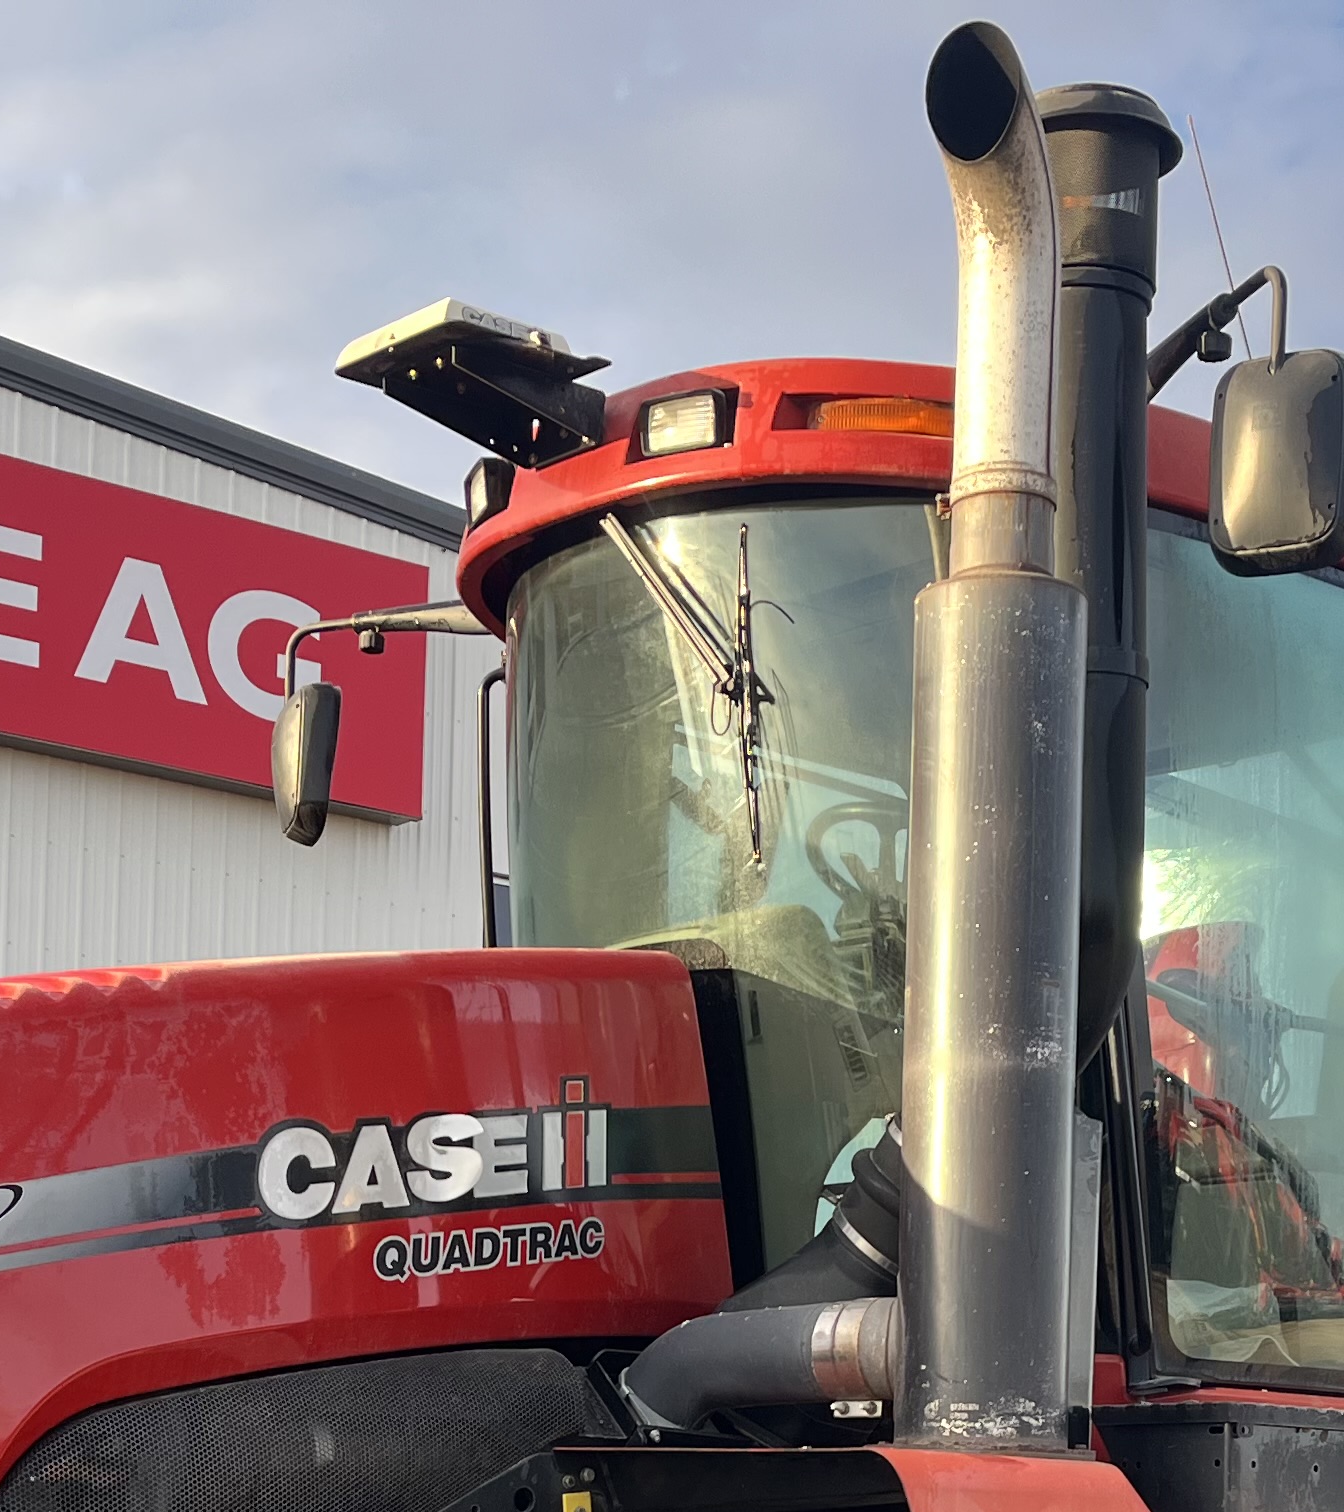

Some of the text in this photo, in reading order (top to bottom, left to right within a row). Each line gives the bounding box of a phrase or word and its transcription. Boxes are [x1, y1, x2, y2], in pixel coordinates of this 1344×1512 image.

[73, 556, 322, 723] AG
[257, 1113, 529, 1221] CASE
[373, 1216, 606, 1284] QUADTRAC
